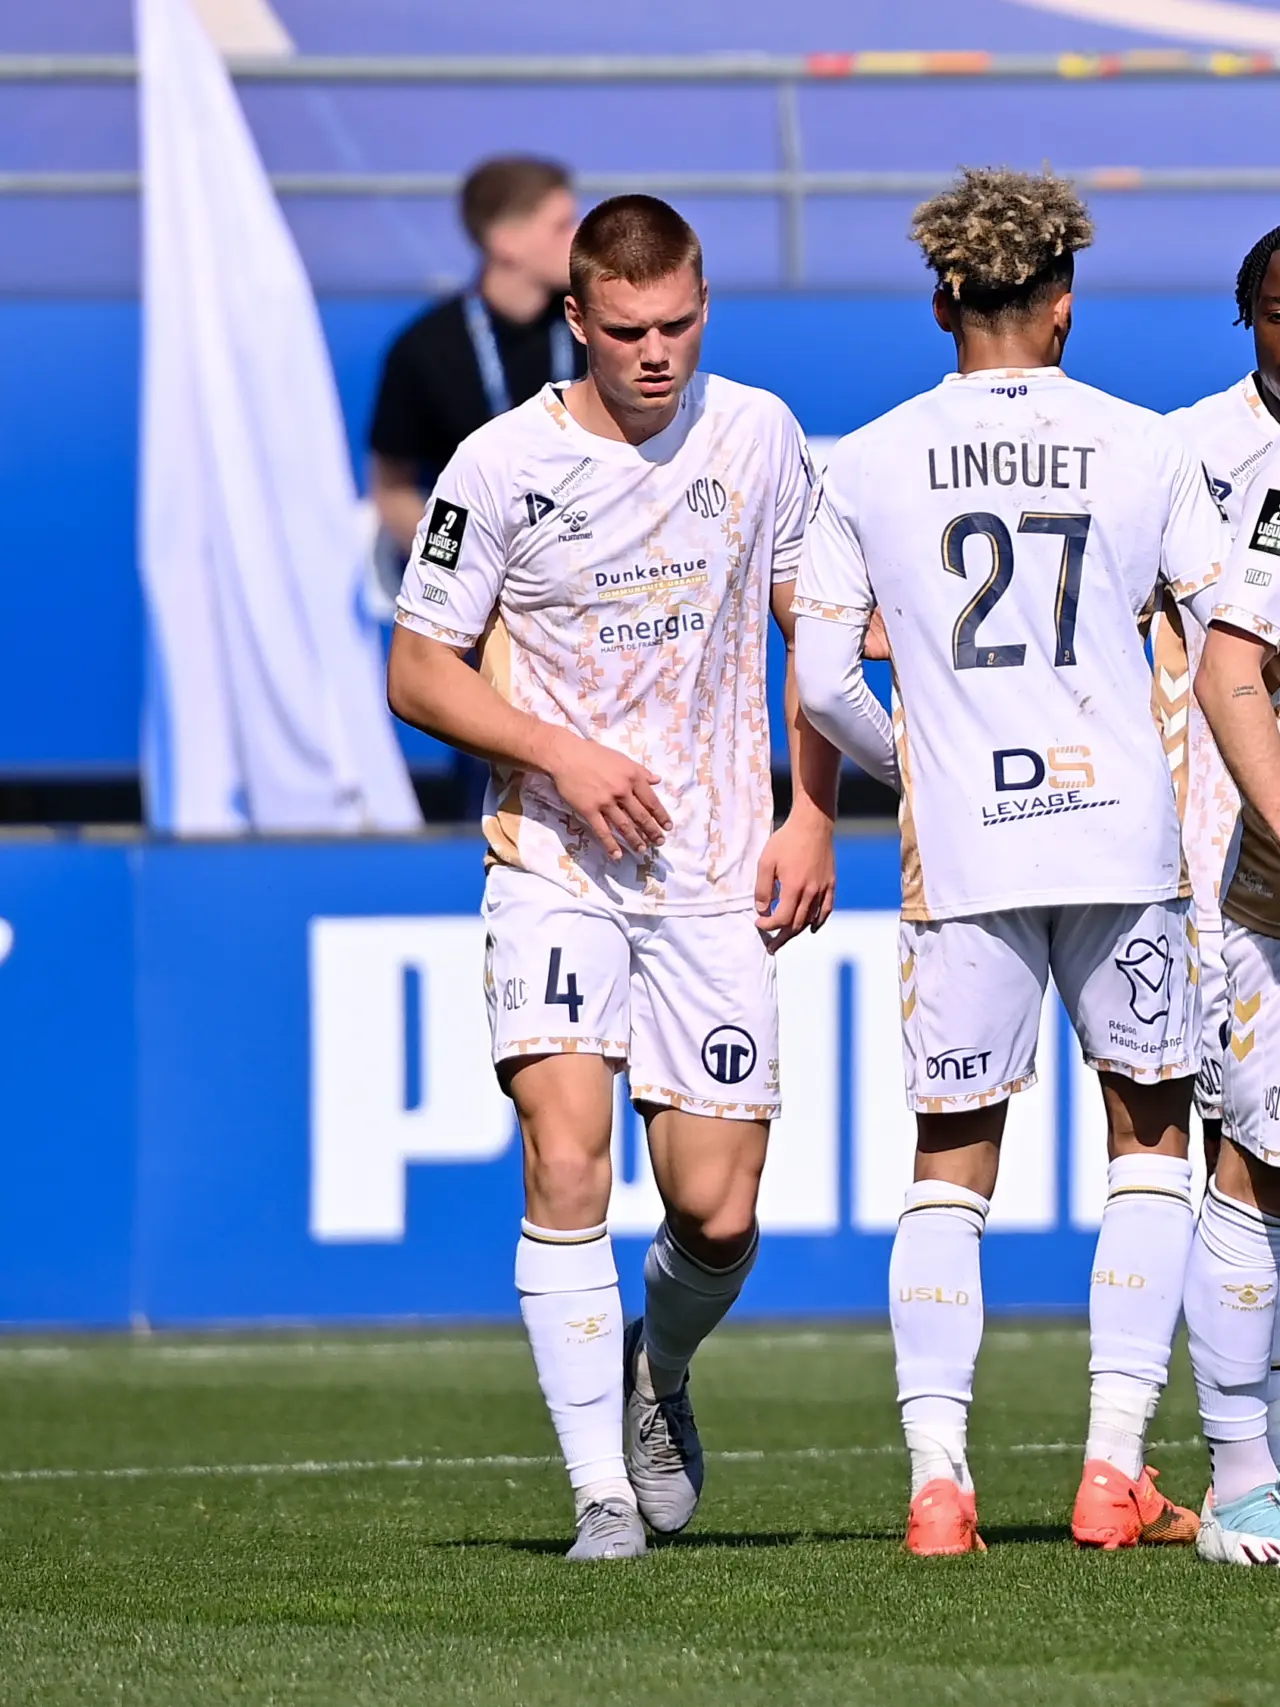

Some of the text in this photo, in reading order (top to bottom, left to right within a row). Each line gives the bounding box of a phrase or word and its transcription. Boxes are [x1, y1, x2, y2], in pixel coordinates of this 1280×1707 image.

[551, 456, 592, 496] Aluminium
[928, 441, 1096, 490] LINGUET
[686, 477, 727, 519] USLD
[438, 510, 458, 537] 2
[558, 531, 593, 543] hummel
[595, 558, 707, 587] Dunkerque
[941, 511, 1092, 670] 27
[600, 612, 705, 644] energia
[992, 745, 1095, 792] DS
[982, 790, 1083, 818] LEVAGE
[545, 947, 584, 1023] 4
[1109, 1020, 1137, 1035] Région
[899, 1286, 969, 1306] USLD
